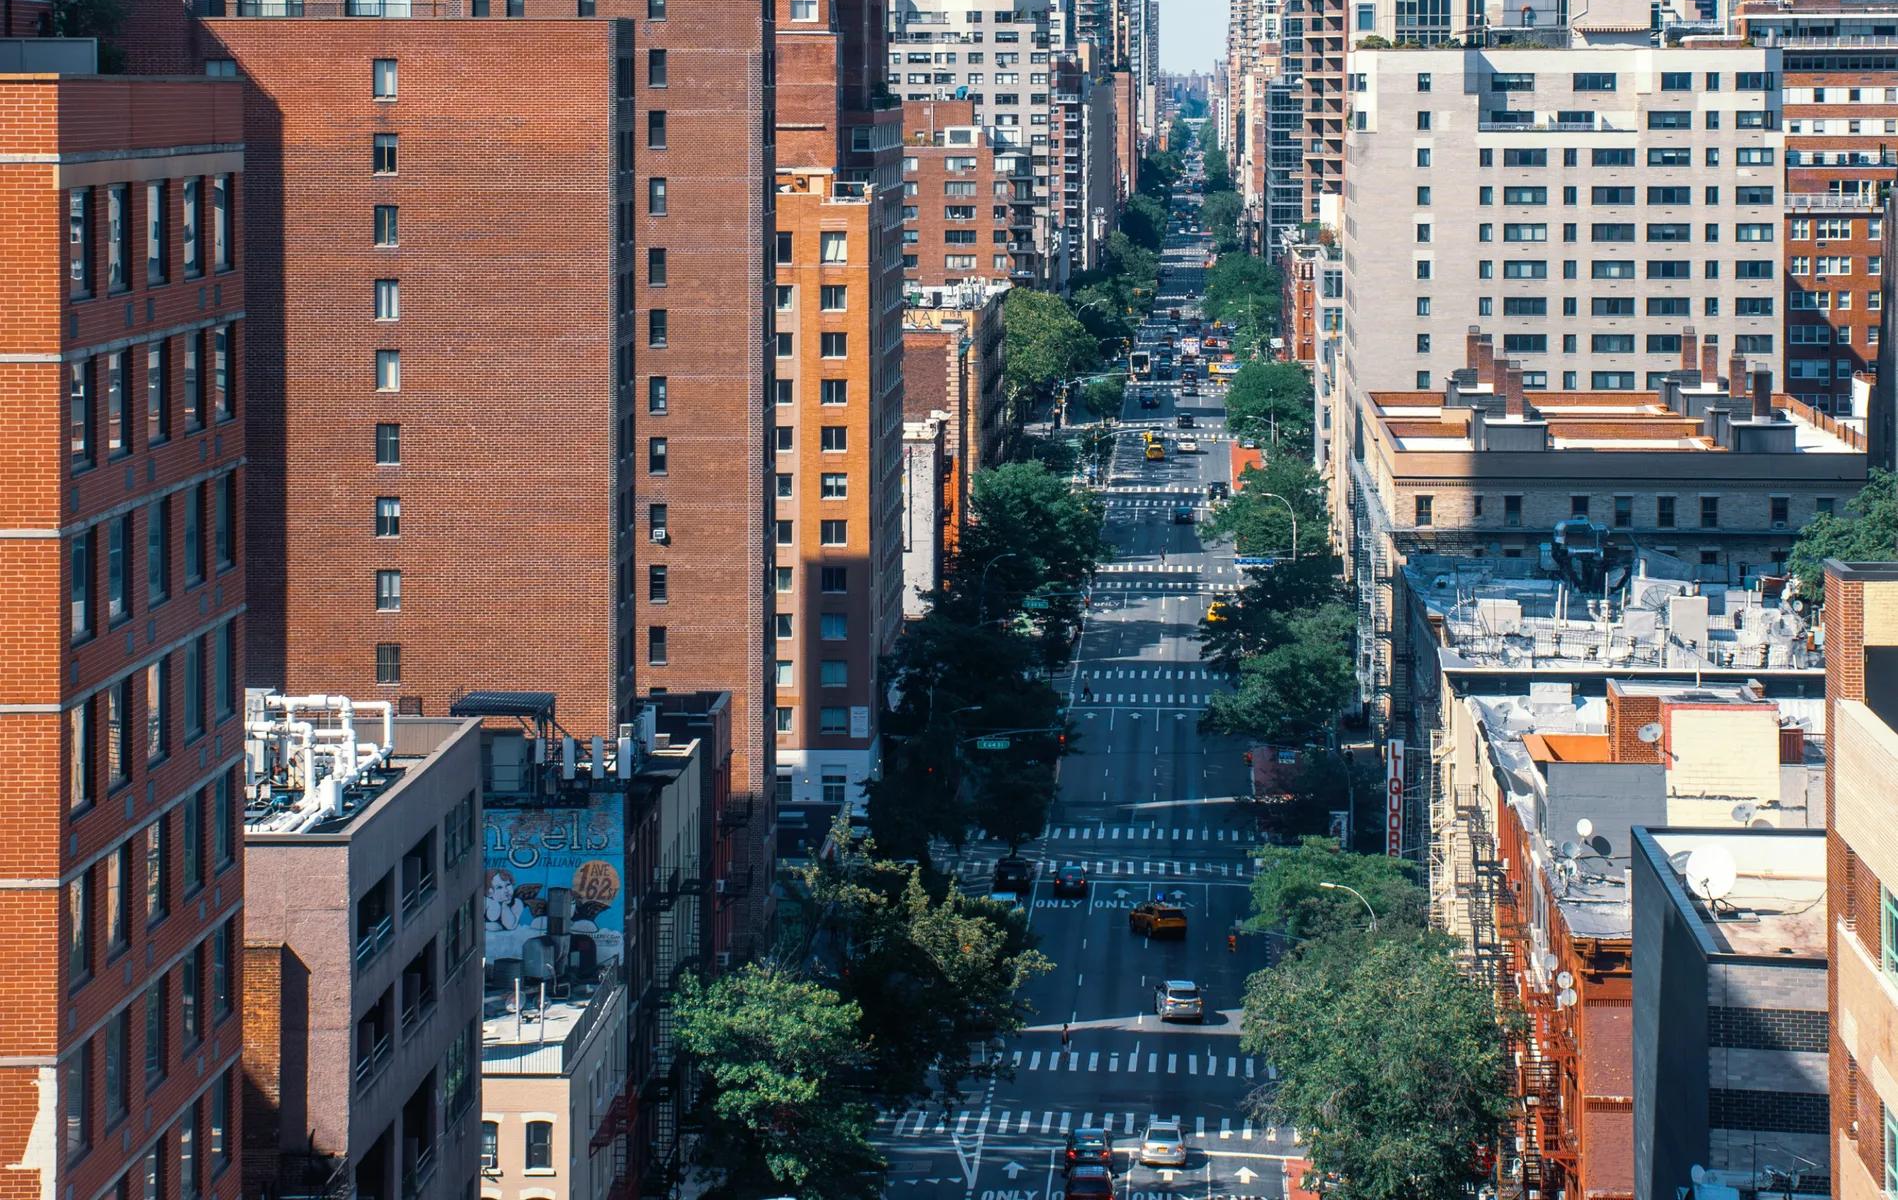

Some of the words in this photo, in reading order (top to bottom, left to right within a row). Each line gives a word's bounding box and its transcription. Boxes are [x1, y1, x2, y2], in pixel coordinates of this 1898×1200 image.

[538, 856, 583, 868] ITALIANO
[590, 863, 610, 877] AVE
[580, 863, 591, 892] 1
[1035, 899, 1082, 908] ONLY
[1094, 900, 1141, 909] ONLY
